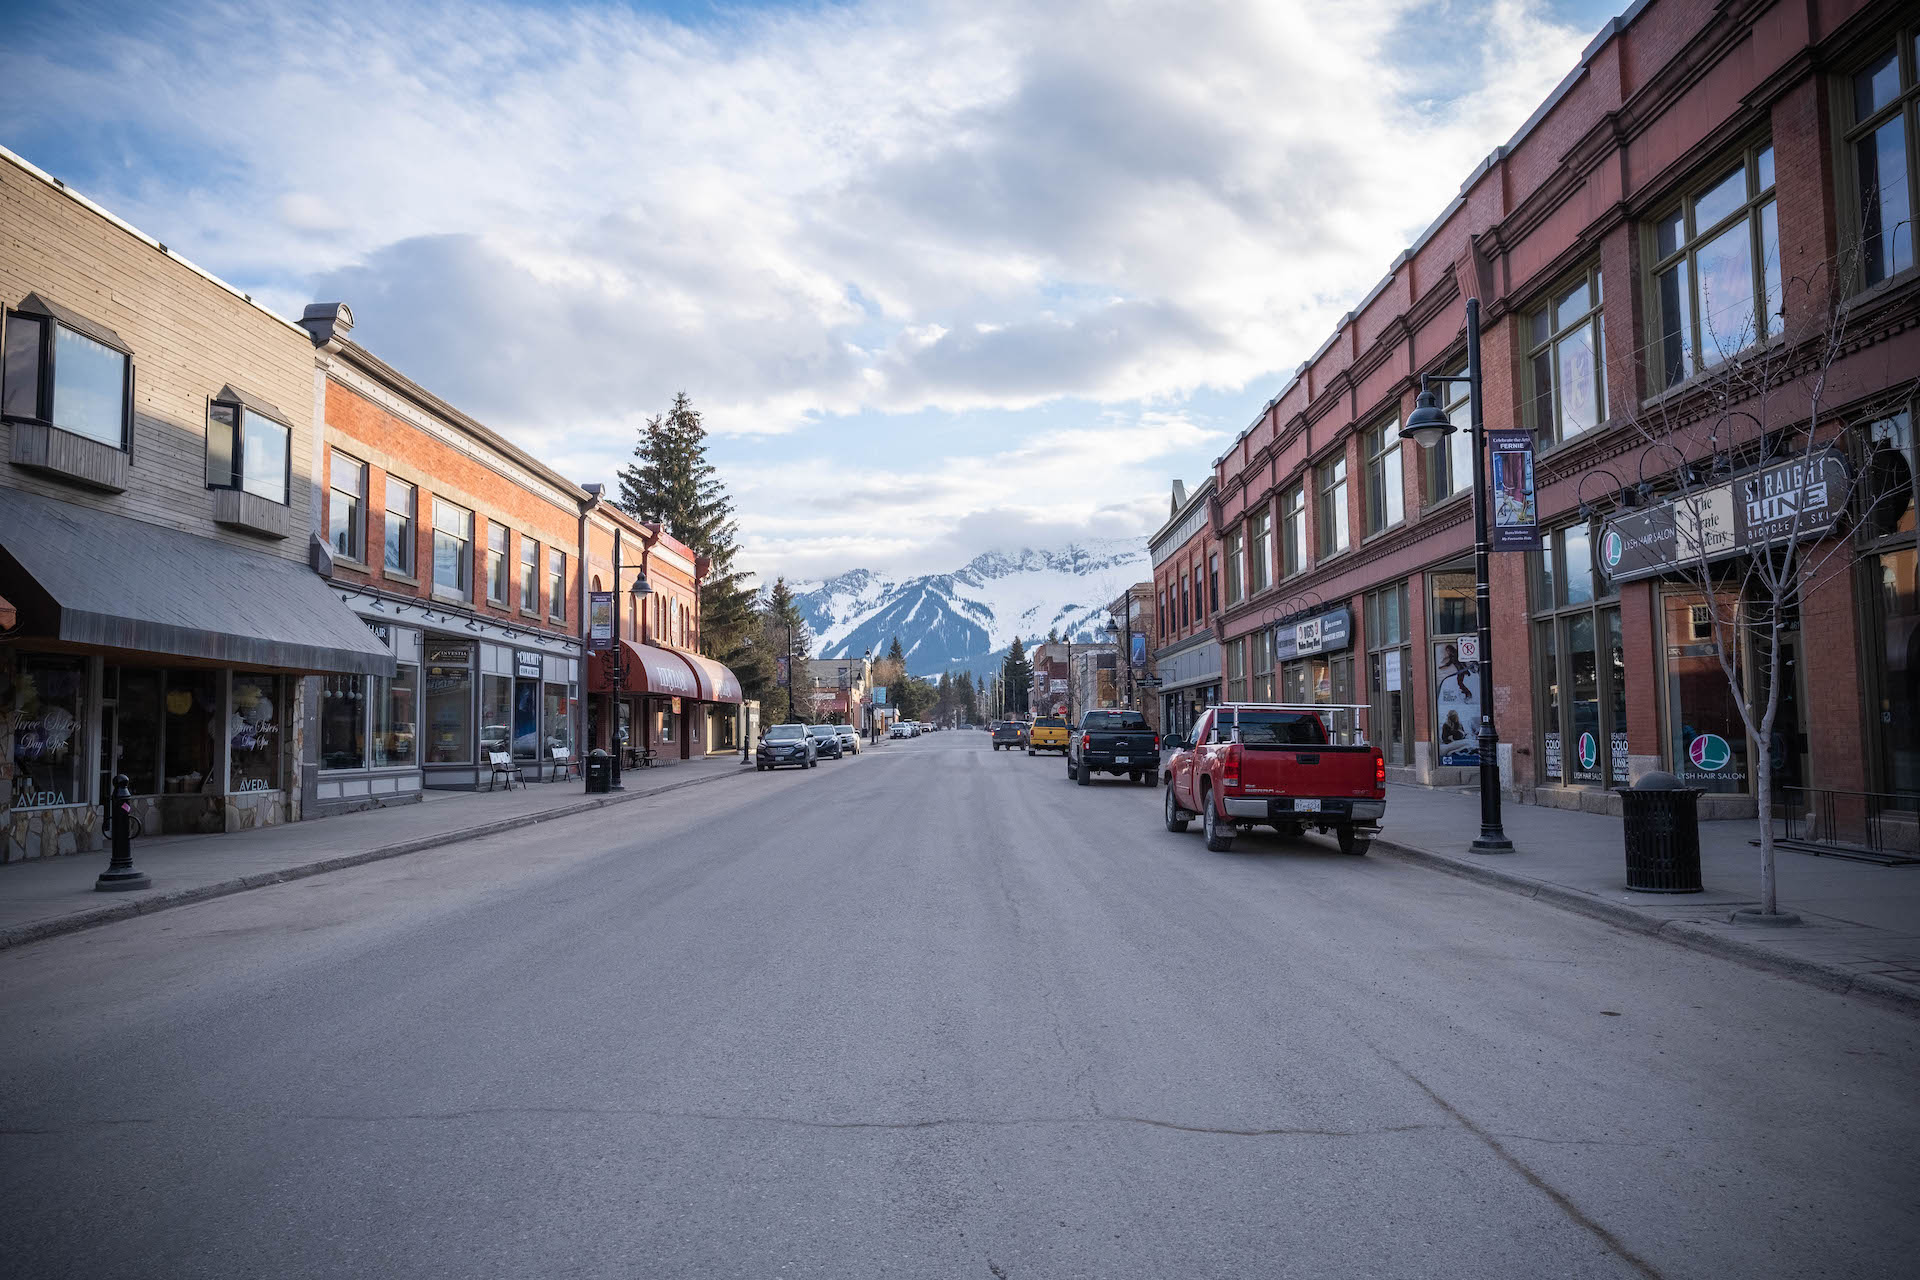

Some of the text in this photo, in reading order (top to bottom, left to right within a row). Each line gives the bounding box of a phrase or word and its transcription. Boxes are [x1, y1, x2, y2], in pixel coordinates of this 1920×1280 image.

[1745, 458, 1825, 502] STRAIGHT
[1746, 481, 1828, 528] LINE
[1748, 521, 1789, 540] BICYCLE
[1811, 511, 1829, 524] SKI
[1624, 528, 1675, 551] LYSH HAIR SALON
[1687, 532, 1727, 551] Ademy
[368, 624, 387, 638] HAIR
[520, 651, 539, 665] COMMIT
[14, 709, 82, 731] Three Sisters
[256, 719, 279, 733] Sisters
[20, 732, 66, 755] Day Spa
[241, 734, 269, 752] Day Spa
[240, 779, 269, 792] AVEDA
[16, 791, 66, 808] AVEDA
